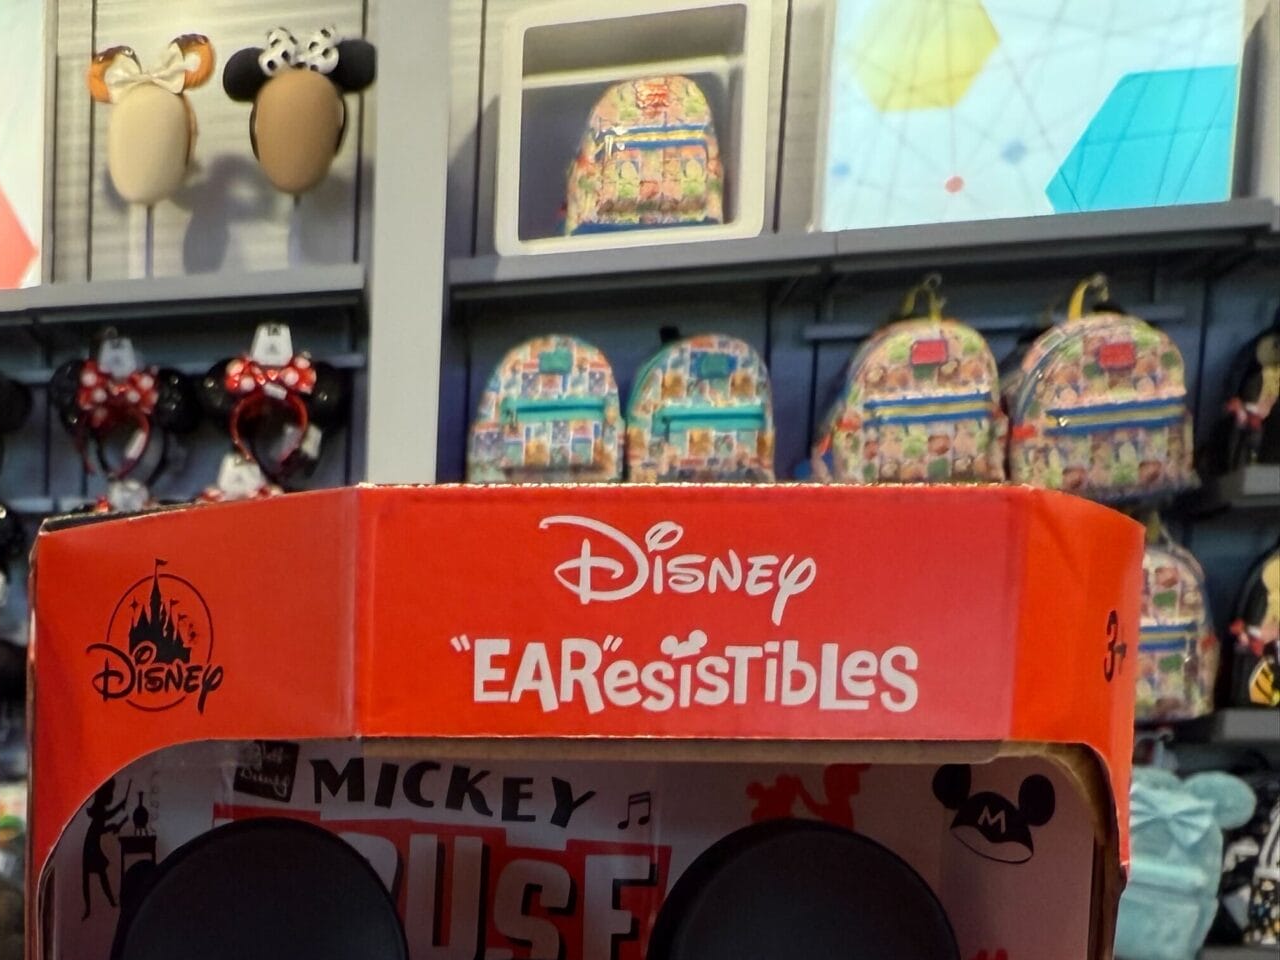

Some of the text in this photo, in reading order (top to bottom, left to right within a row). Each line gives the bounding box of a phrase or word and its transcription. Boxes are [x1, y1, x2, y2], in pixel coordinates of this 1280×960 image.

[538, 513, 817, 626] Disney
[85, 641, 224, 715] Disney
[308, 756, 597, 829] MICKEY
[977, 805, 1007, 834] M
